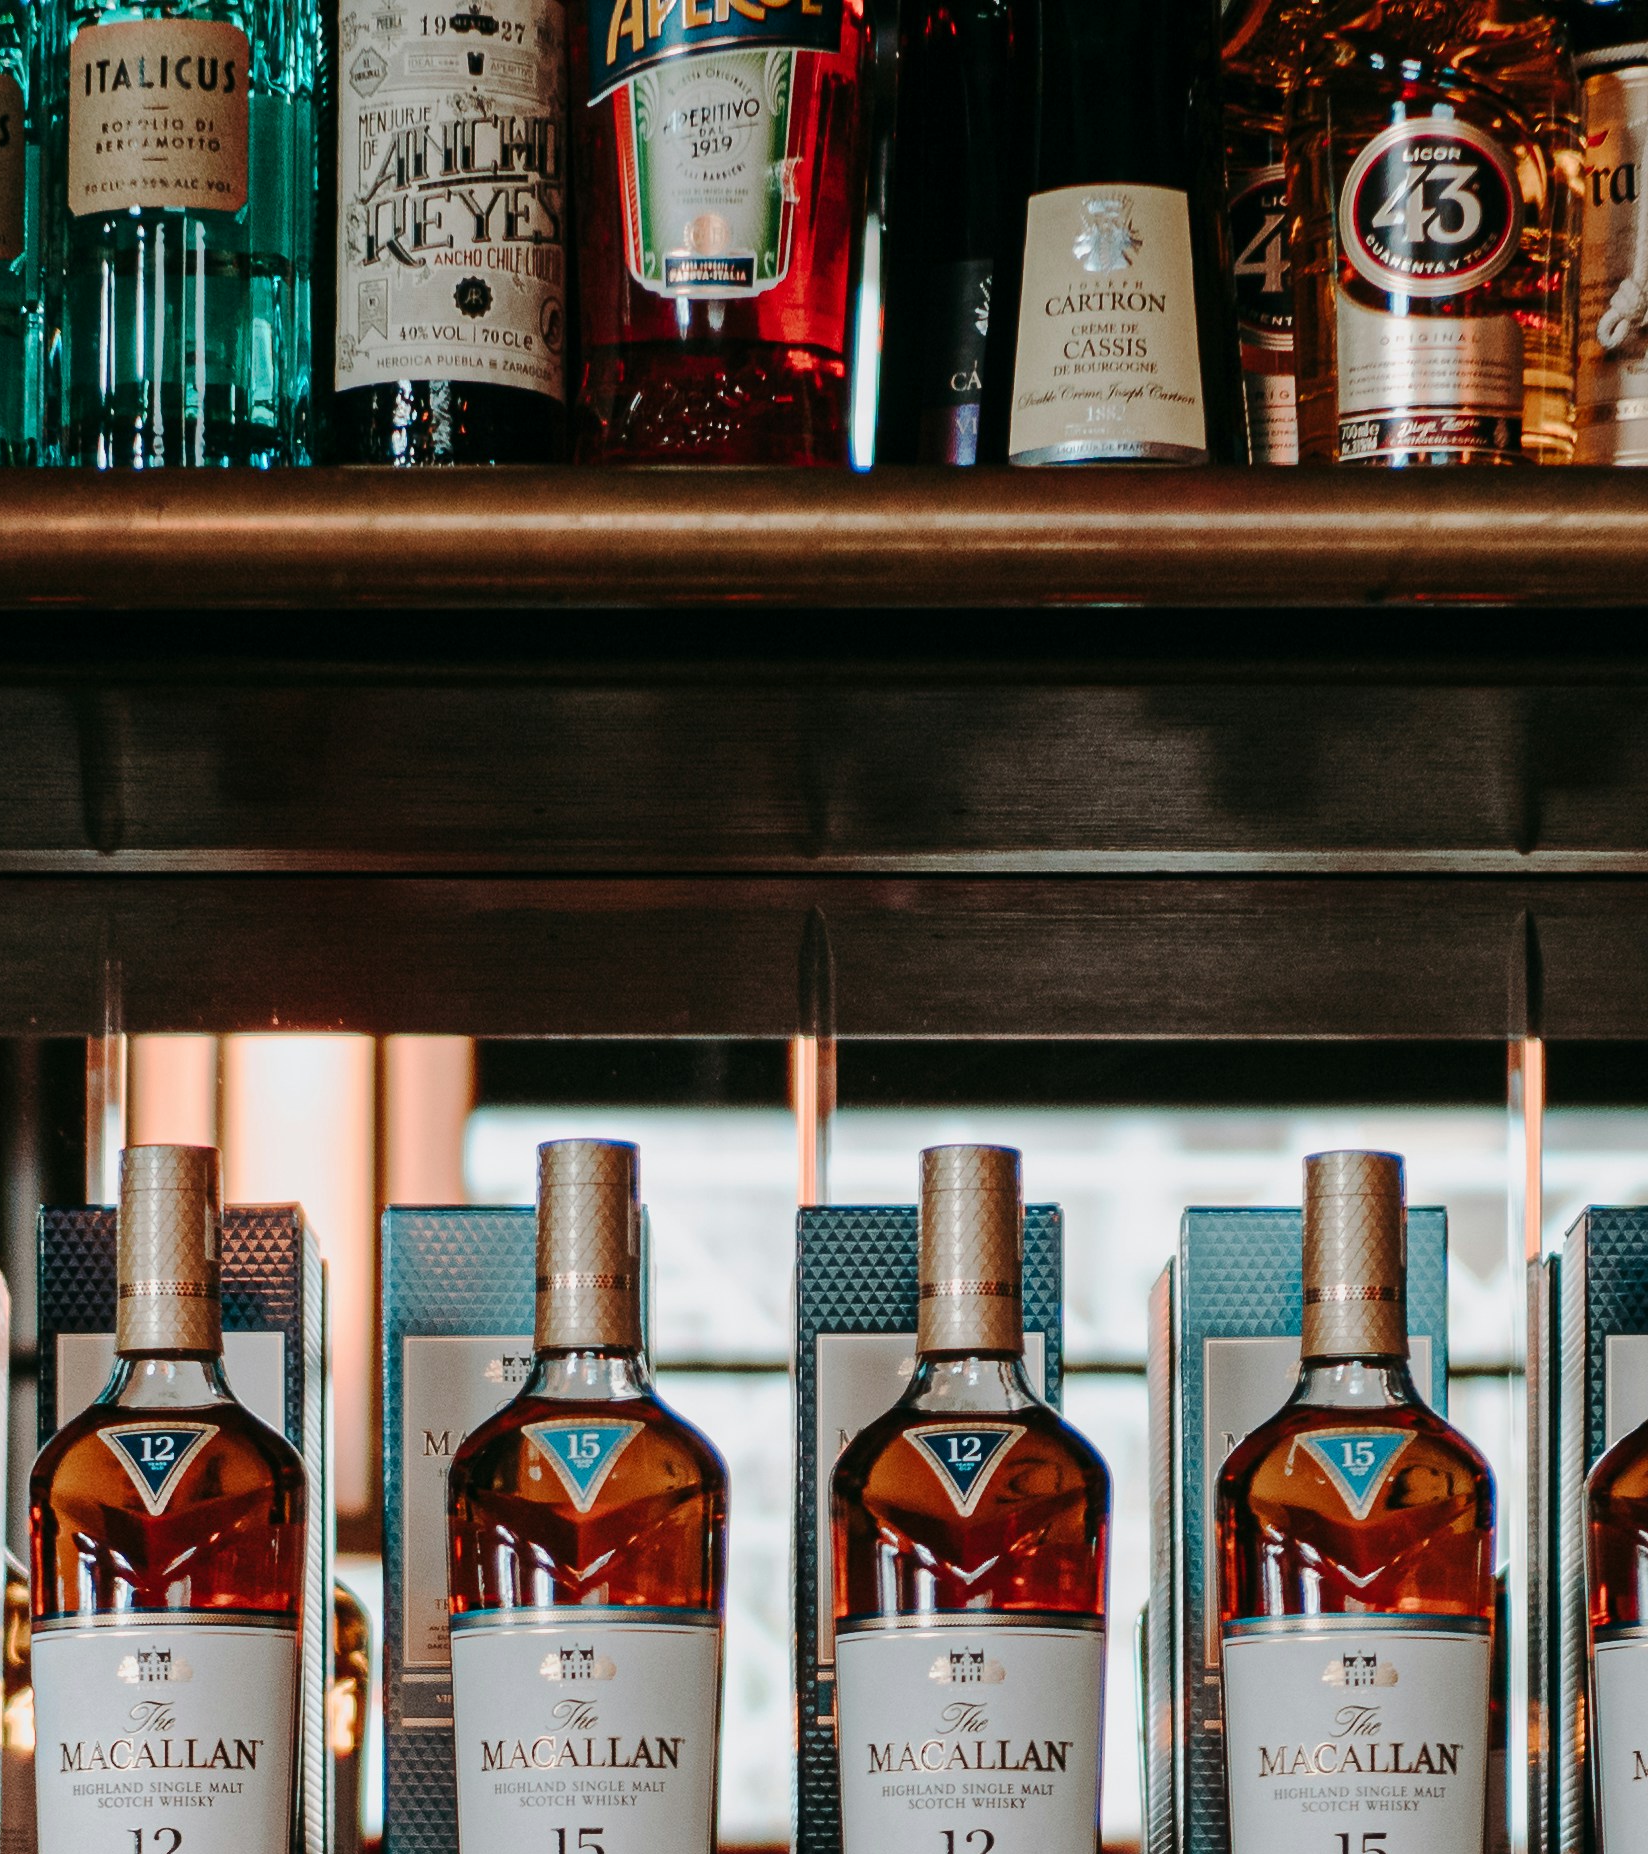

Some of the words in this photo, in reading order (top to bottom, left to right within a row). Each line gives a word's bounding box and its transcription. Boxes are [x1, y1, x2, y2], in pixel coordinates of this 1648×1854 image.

[421, 16, 446, 36] 19
[502, 21, 525, 44] 27
[85, 55, 235, 96] ITALICUS
[102, 118, 183, 134] ROOLIO
[196, 119, 214, 132] DI
[359, 107, 431, 134] MENJURJE
[663, 98, 760, 135] APERITIVO
[699, 125, 723, 136] DAL
[364, 141, 378, 170] DE
[691, 136, 733, 159] 1919
[1403, 147, 1461, 162] LICOR
[1372, 165, 1482, 243] 43
[362, 181, 562, 267] REYES
[434, 250, 482, 267] ANCHO
[488, 248, 523, 273] CHILE
[1234, 213, 1291, 292] 4
[1365, 234, 1445, 273] CUARENTA
[1450, 259, 1460, 270] Y
[1069, 280, 1143, 290] JOSEPH
[1045, 292, 1166, 317] CARTRON
[400, 326, 428, 341] 40%
[432, 326, 465, 341] VOL
[1122, 324, 1138, 334] DE
[1064, 338, 1147, 360] CASSIS
[378, 357, 431, 368] HEROICA
[438, 357, 483, 368] PUEBLA
[1054, 365, 1069, 377] DE
[1073, 361, 1158, 375] BOURGOGNE
[140, 1436, 175, 1462] 12
[565, 1432, 601, 1459] 15
[947, 1436, 982, 1462] 12
[1341, 1441, 1376, 1467] 15
[123, 1701, 175, 1733] The
[546, 1700, 599, 1730] The
[936, 1702, 988, 1733] The
[1330, 1706, 1382, 1737] The
[60, 1738, 261, 1771] MACALLAN
[481, 1737, 681, 1770] MACALLAN
[869, 1740, 1069, 1772] MACALLAN
[1259, 1743, 1460, 1776] MACALLAN
[73, 1783, 143, 1795] HIGHLAND
[150, 1782, 202, 1793] SINGLE
[210, 1782, 243, 1793] MALT
[495, 1782, 566, 1794] HIGHLAND
[572, 1781, 625, 1792] SINGLE
[632, 1781, 665, 1793] MALT
[882, 1784, 955, 1796] HIGHLAND
[962, 1783, 1015, 1794] SINGLE
[1021, 1784, 1053, 1796] MALT
[98, 1796, 153, 1808] SCOTCH
[160, 1795, 216, 1808] WHISKY
[520, 1795, 575, 1807] SCOTCH
[582, 1795, 637, 1807] WHISKY
[909, 1798, 965, 1809] SCOTCH
[972, 1798, 1026, 1809] WHISKY
